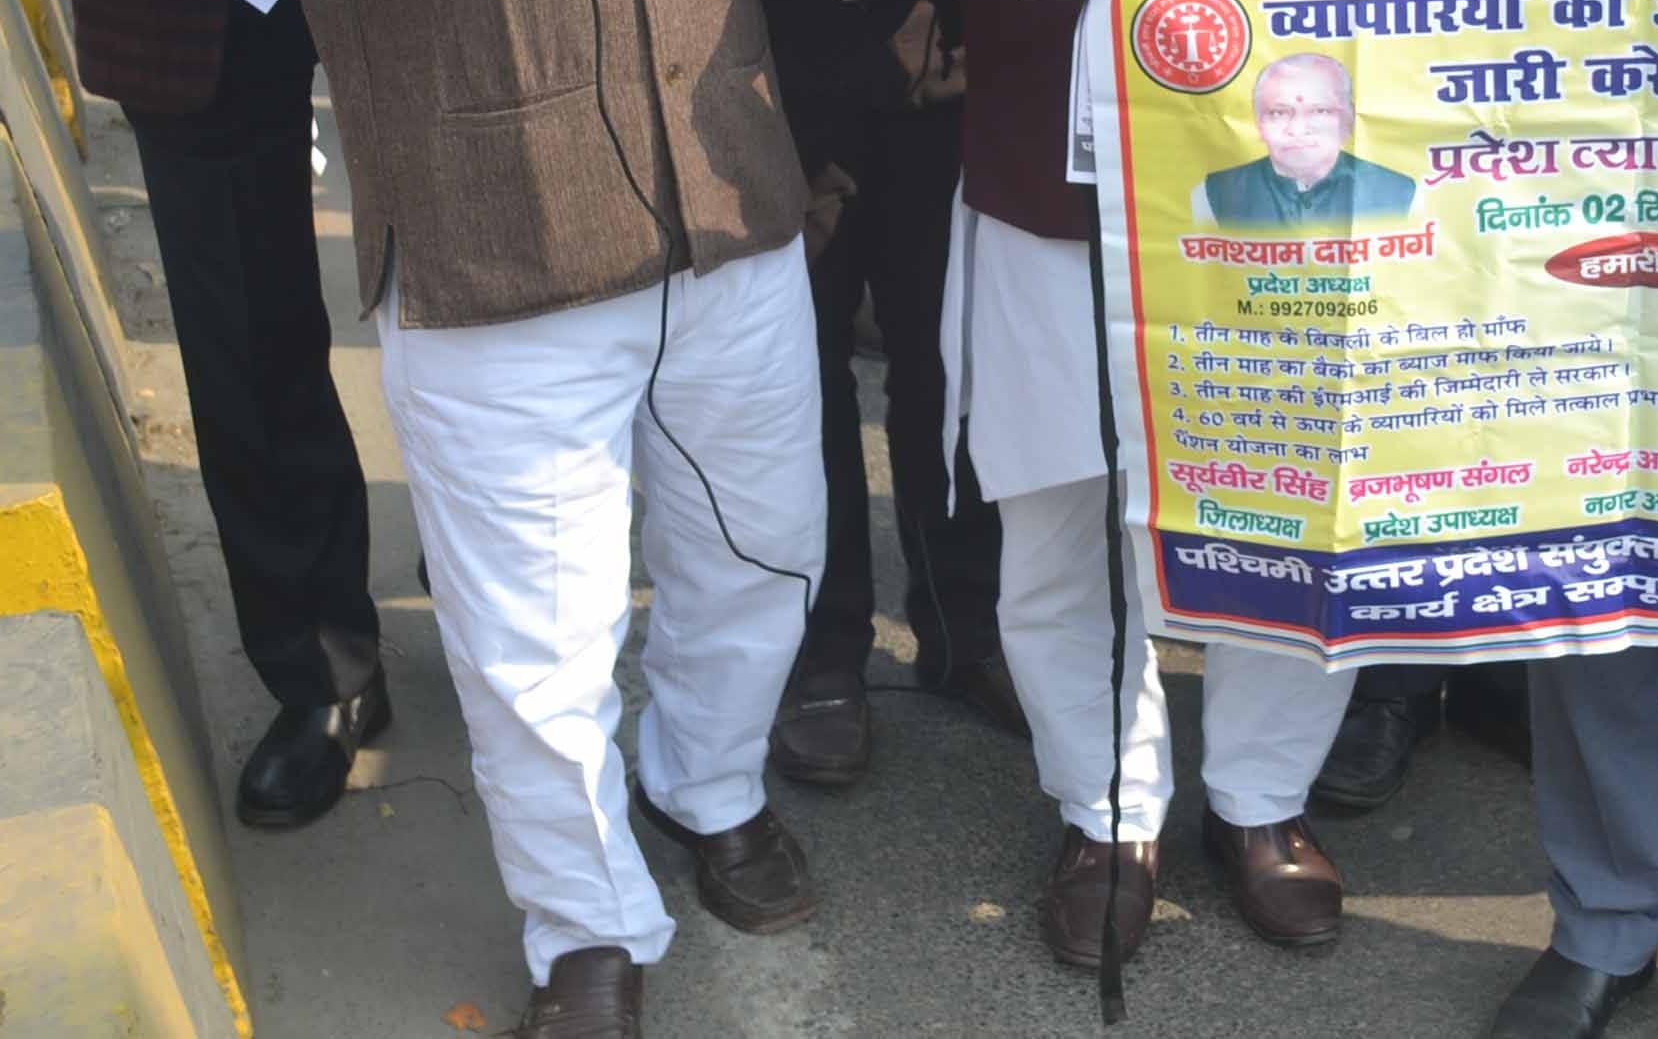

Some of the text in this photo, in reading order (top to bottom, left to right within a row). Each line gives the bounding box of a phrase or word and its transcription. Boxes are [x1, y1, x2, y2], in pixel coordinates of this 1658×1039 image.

[1430, 49, 1566, 103] जारी
[1426, 129, 1559, 184] प्रदेश
[1476, 195, 1571, 233] दिनांक
[1583, 194, 1625, 224] 02
[1180, 223, 1435, 267] घनश्याम दास गर्ग
[1248, 275, 1370, 296] प्रदेश अध्यक्ष
[1270, 299, 1378, 317] 9927092606
[1193, 322, 1230, 342] तीन
[1236, 329, 1272, 346] माह
[1276, 328, 1299, 346] के
[1305, 328, 1370, 349] बिजली
[1379, 325, 1399, 345] के
[1407, 323, 1448, 343] बिल
[1456, 318, 1476, 339] हो
[1193, 352, 1229, 372] तीन
[1236, 358, 1272, 376] माह
[1278, 360, 1305, 376] का
[1363, 359, 1391, 375] का
[1398, 354, 1449, 371] ब्याज
[1455, 350, 1498, 365] माफ
[1506, 345, 1555, 361] किया
[1194, 379, 1230, 399] तीन
[1237, 386, 1272, 403] माह
[1277, 384, 1304, 403] की
[1311, 383, 1392, 411] ईएमआई
[1399, 379, 1426, 399] की
[1434, 368, 1520, 396] जिम्मेदारी
[1527, 366, 1548, 386] ले
[1199, 411, 1224, 426] 60
[1230, 408, 1262, 428] वर्ष
[1270, 410, 1287, 430] से
[1294, 416, 1336, 434] ऊपर
[1341, 414, 1362, 433] के
[1369, 404, 1464, 429] व्यापारियों
[1470, 399, 1498, 420] को
[1506, 394, 1546, 417] मिले
[1552, 392, 1620, 413] तत्काल
[1225, 434, 1288, 457] योजना
[1294, 443, 1320, 460] का
[1327, 446, 1369, 464] लाभ
[1567, 449, 1630, 476] नरेन्द्र
[1169, 460, 1330, 501] सूर्यवीर सिंह
[1350, 459, 1532, 504] ब्रजभूषण संगल
[1197, 498, 1303, 539] जिलाध्यक्ष
[1585, 490, 1636, 514] नगर
[1363, 505, 1519, 542] प्रदेश उपाध्यक्ष
[1175, 542, 1314, 585] पश्चिमी
[1323, 557, 1428, 594] उत्तर
[1434, 543, 1531, 586] प्रदेश
[1349, 592, 1459, 622] कार्य
[1471, 585, 1551, 613] क्षेत्र
